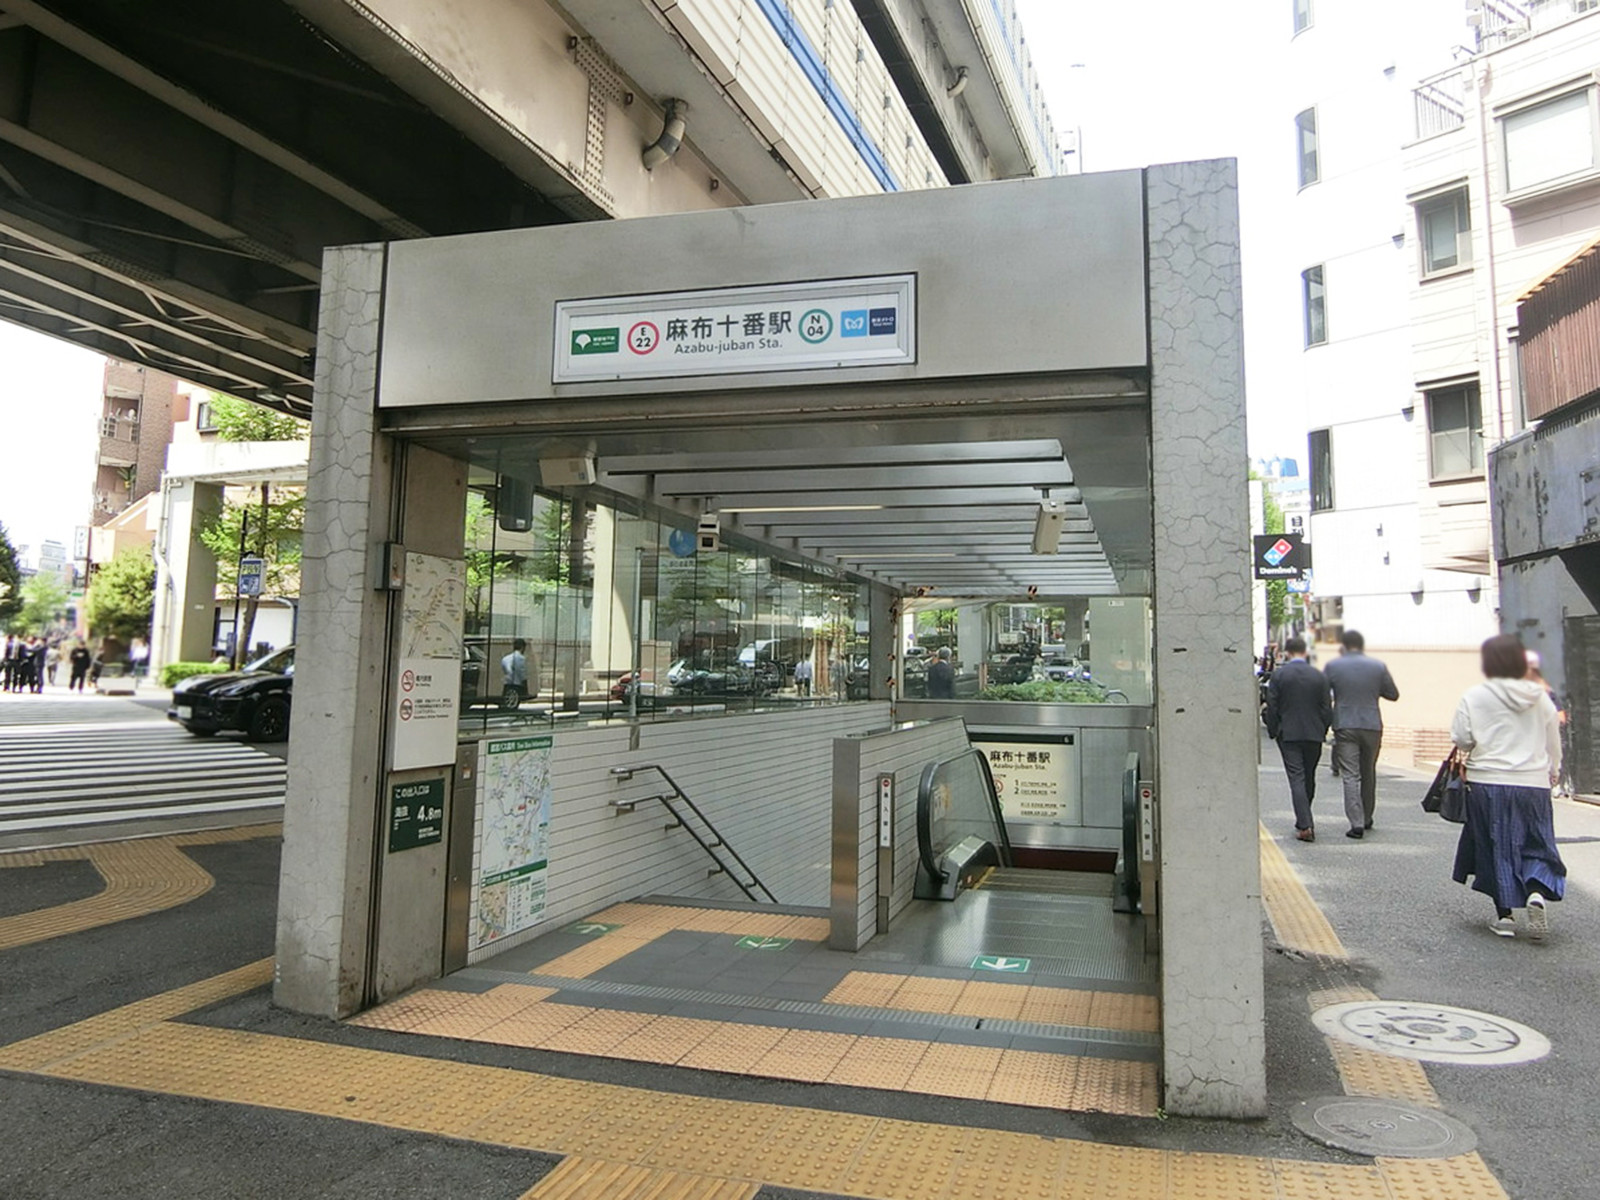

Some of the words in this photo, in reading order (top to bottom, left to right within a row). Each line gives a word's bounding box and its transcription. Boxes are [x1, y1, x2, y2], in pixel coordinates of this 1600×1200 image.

[810, 315, 820, 324] N
[666, 310, 792, 341] 麻布十番駅
[641, 327, 647, 336] E
[807, 326, 824, 337] 04
[636, 337, 651, 347] 22
[674, 340, 754, 354] Azabu-juban
[759, 338, 783, 349] Sta.
[1259, 565, 1297, 574] Domino's
[990, 750, 1051, 764] 麻布十番駅
[1014, 786, 1019, 794] 2
[417, 805, 442, 822] 4.8m
